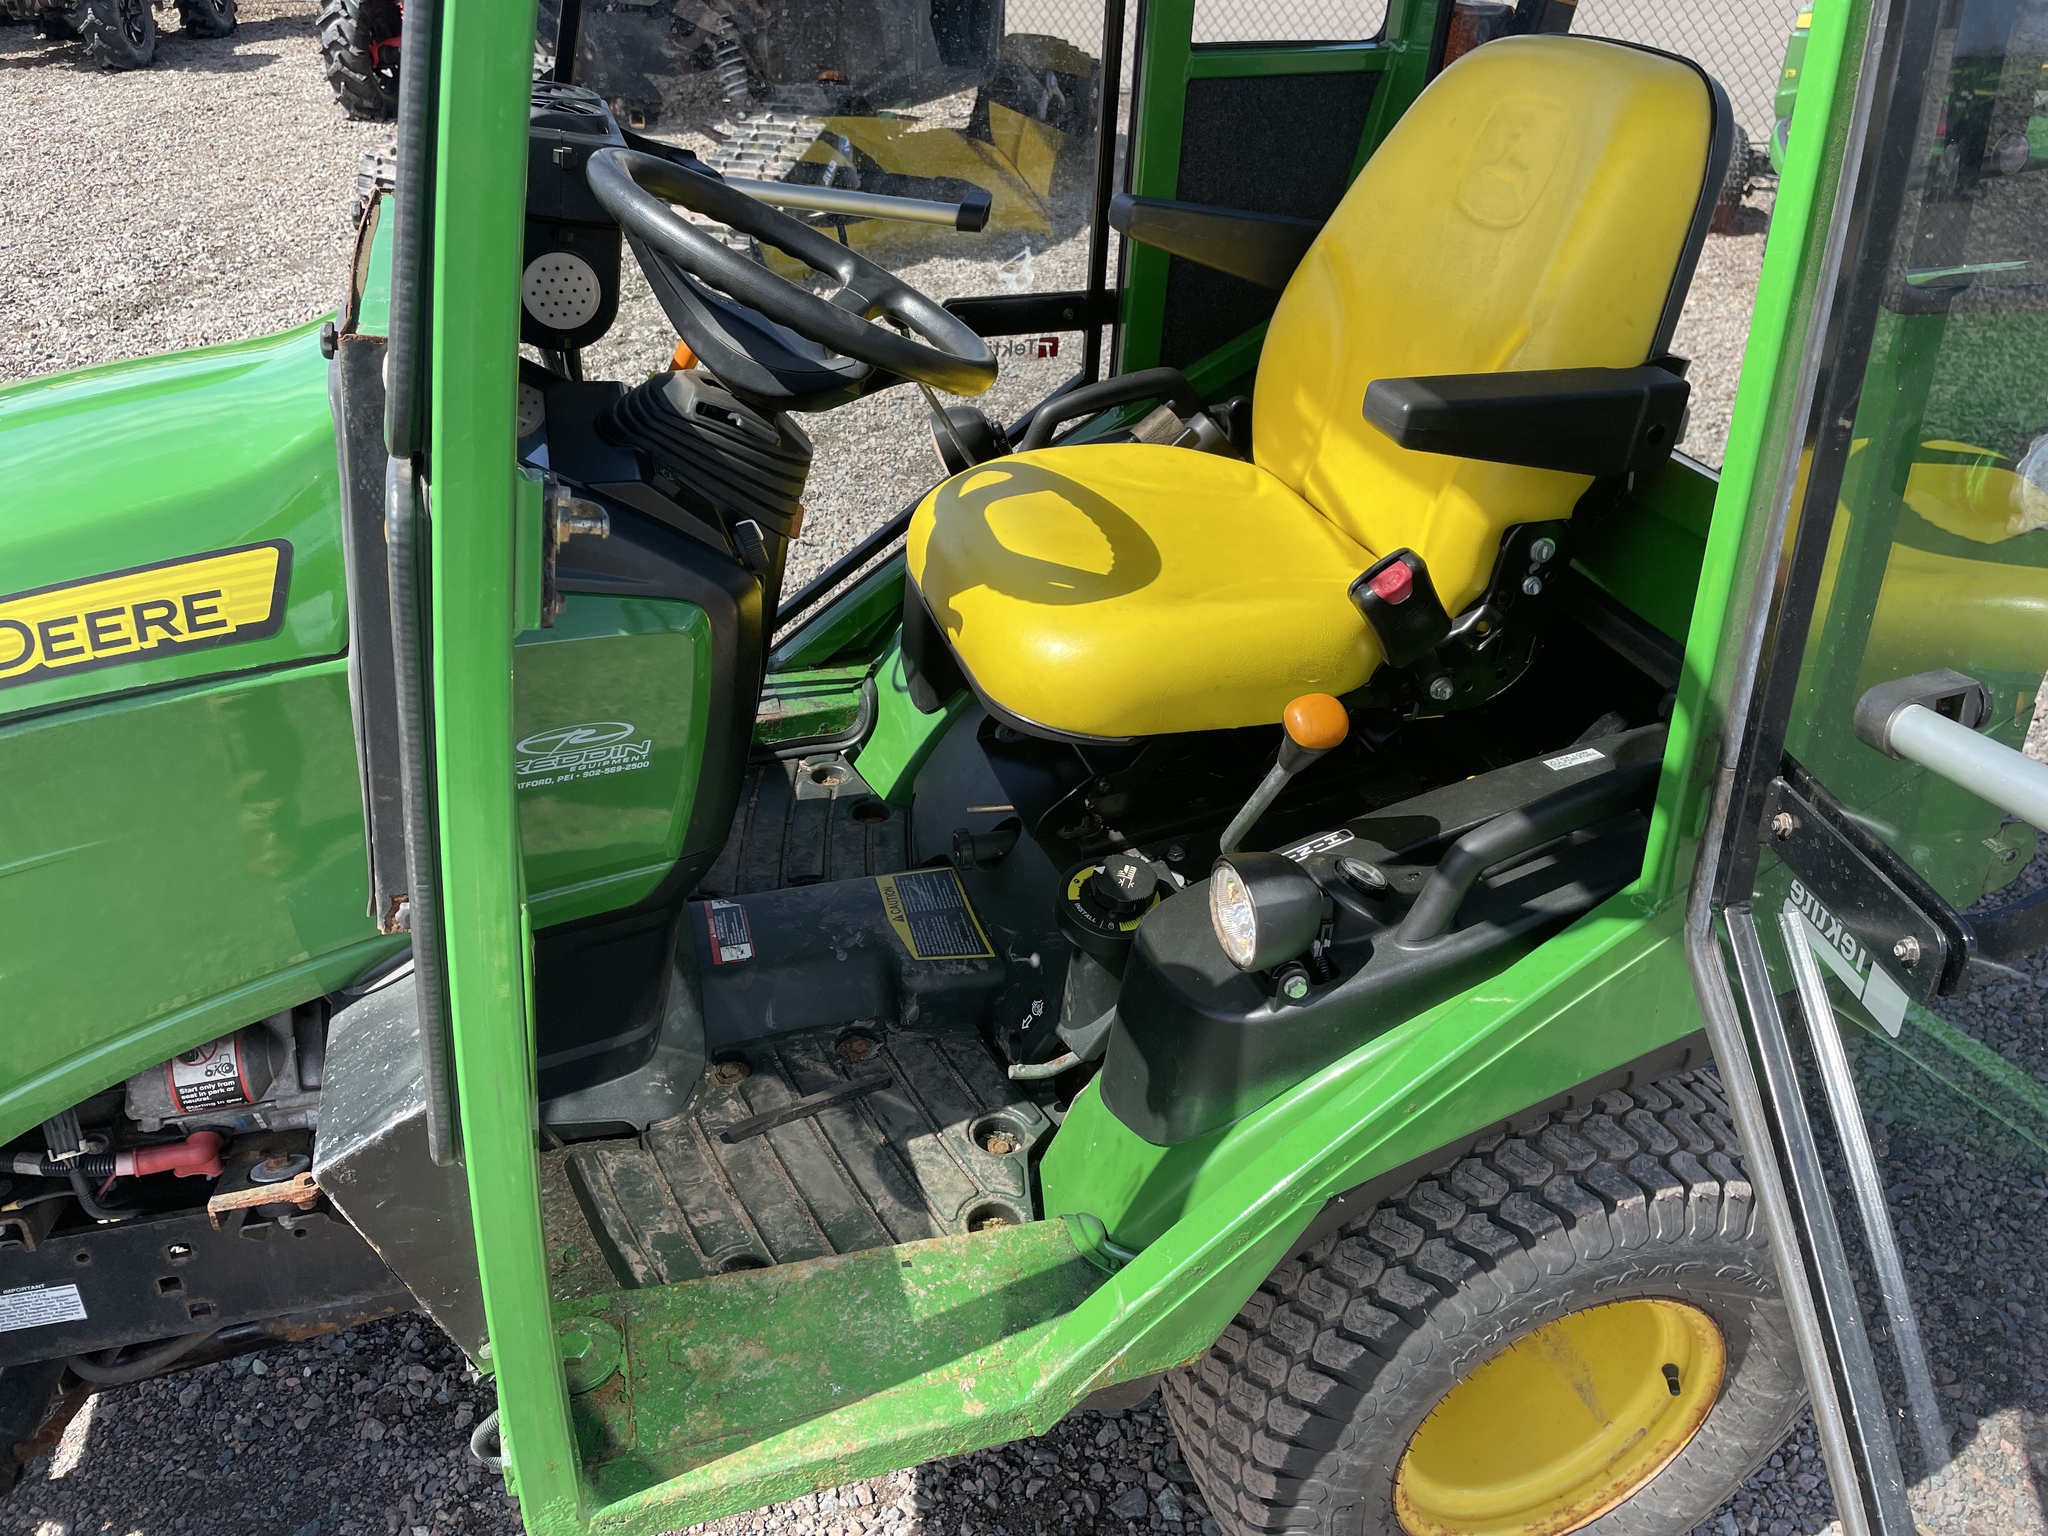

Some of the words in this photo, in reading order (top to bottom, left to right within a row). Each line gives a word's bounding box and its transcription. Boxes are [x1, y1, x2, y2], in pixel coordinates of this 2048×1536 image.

[0, 589, 228, 671] DEERE
[569, 754, 648, 772] EQUIPMENT
[557, 774, 574, 783] PEI
[883, 886, 901, 915] CAUTION
[1074, 902, 1096, 923] INSTALL
[179, 1086, 198, 1094] Start
[199, 1083, 216, 1091] only
[208, 1088, 225, 1096] park
[3, 1283, 45, 1294] IMPORTANT
